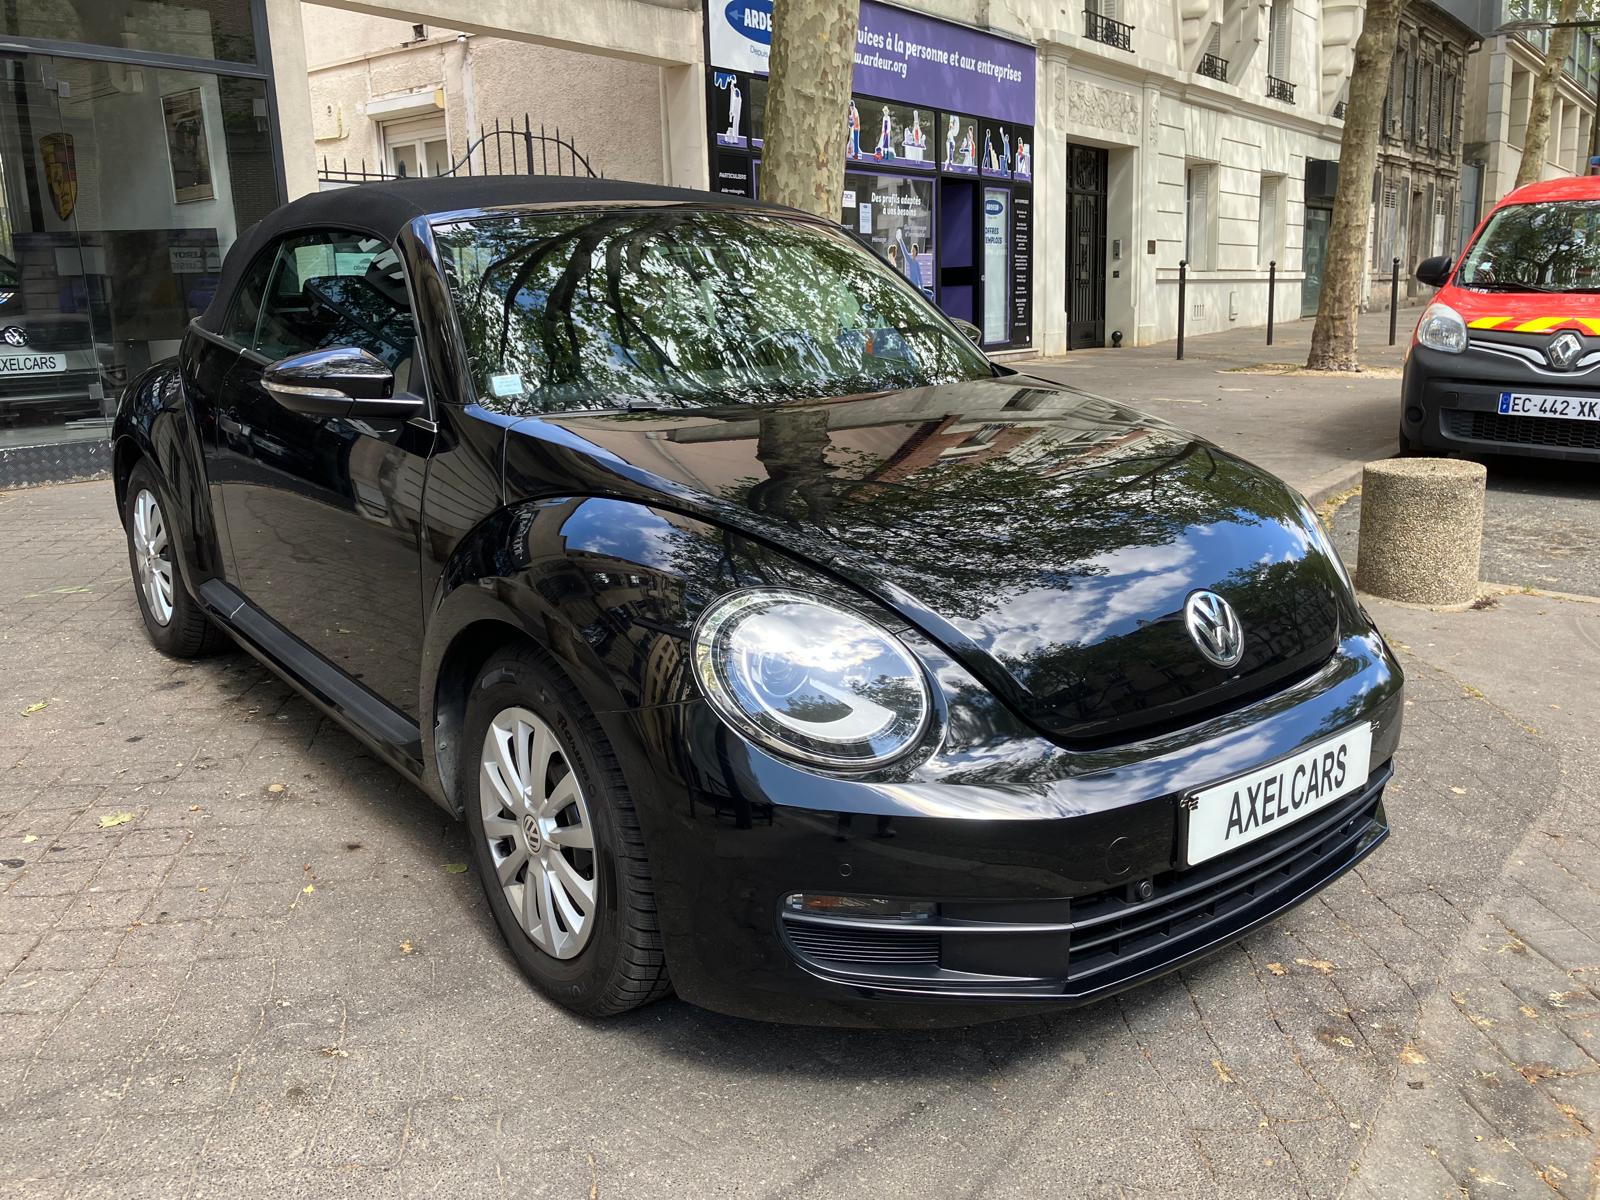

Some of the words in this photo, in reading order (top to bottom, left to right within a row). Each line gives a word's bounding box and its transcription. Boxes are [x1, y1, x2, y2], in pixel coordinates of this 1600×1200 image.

[886, 32, 893, 51] à
[894, 33, 904, 54] la
[905, 41, 949, 64] personne
[949, 51, 959, 67] et
[960, 55, 975, 71] aux
[977, 60, 1022, 83] entreprises
[871, 192, 882, 203] Des
[882, 193, 900, 207] profils
[1225, 743, 1348, 841] AXELCARS
